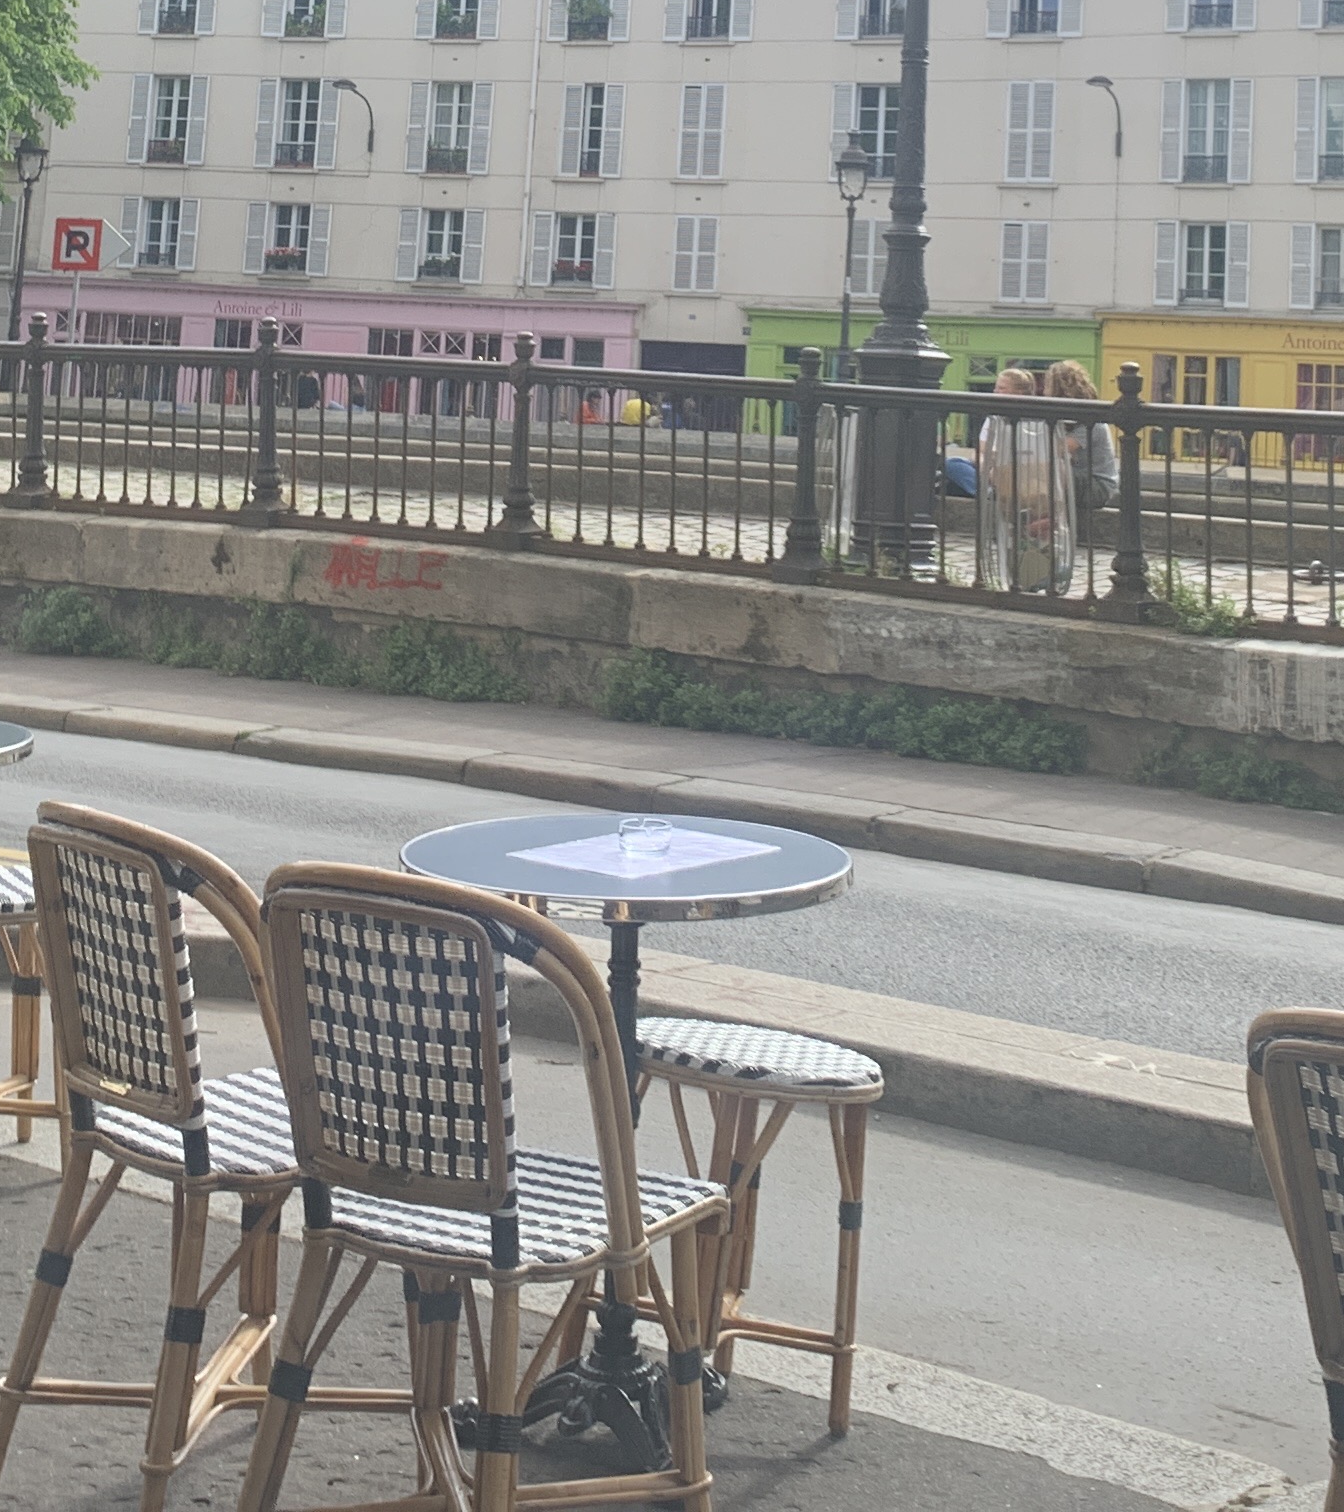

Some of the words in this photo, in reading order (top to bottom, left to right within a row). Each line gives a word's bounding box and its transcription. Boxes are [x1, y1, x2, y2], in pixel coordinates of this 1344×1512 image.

[65, 231, 89, 258] P
[214, 300, 260, 315] Antoine
[282, 302, 302, 317] Lili
[1281, 332, 1344, 351] Antoine
